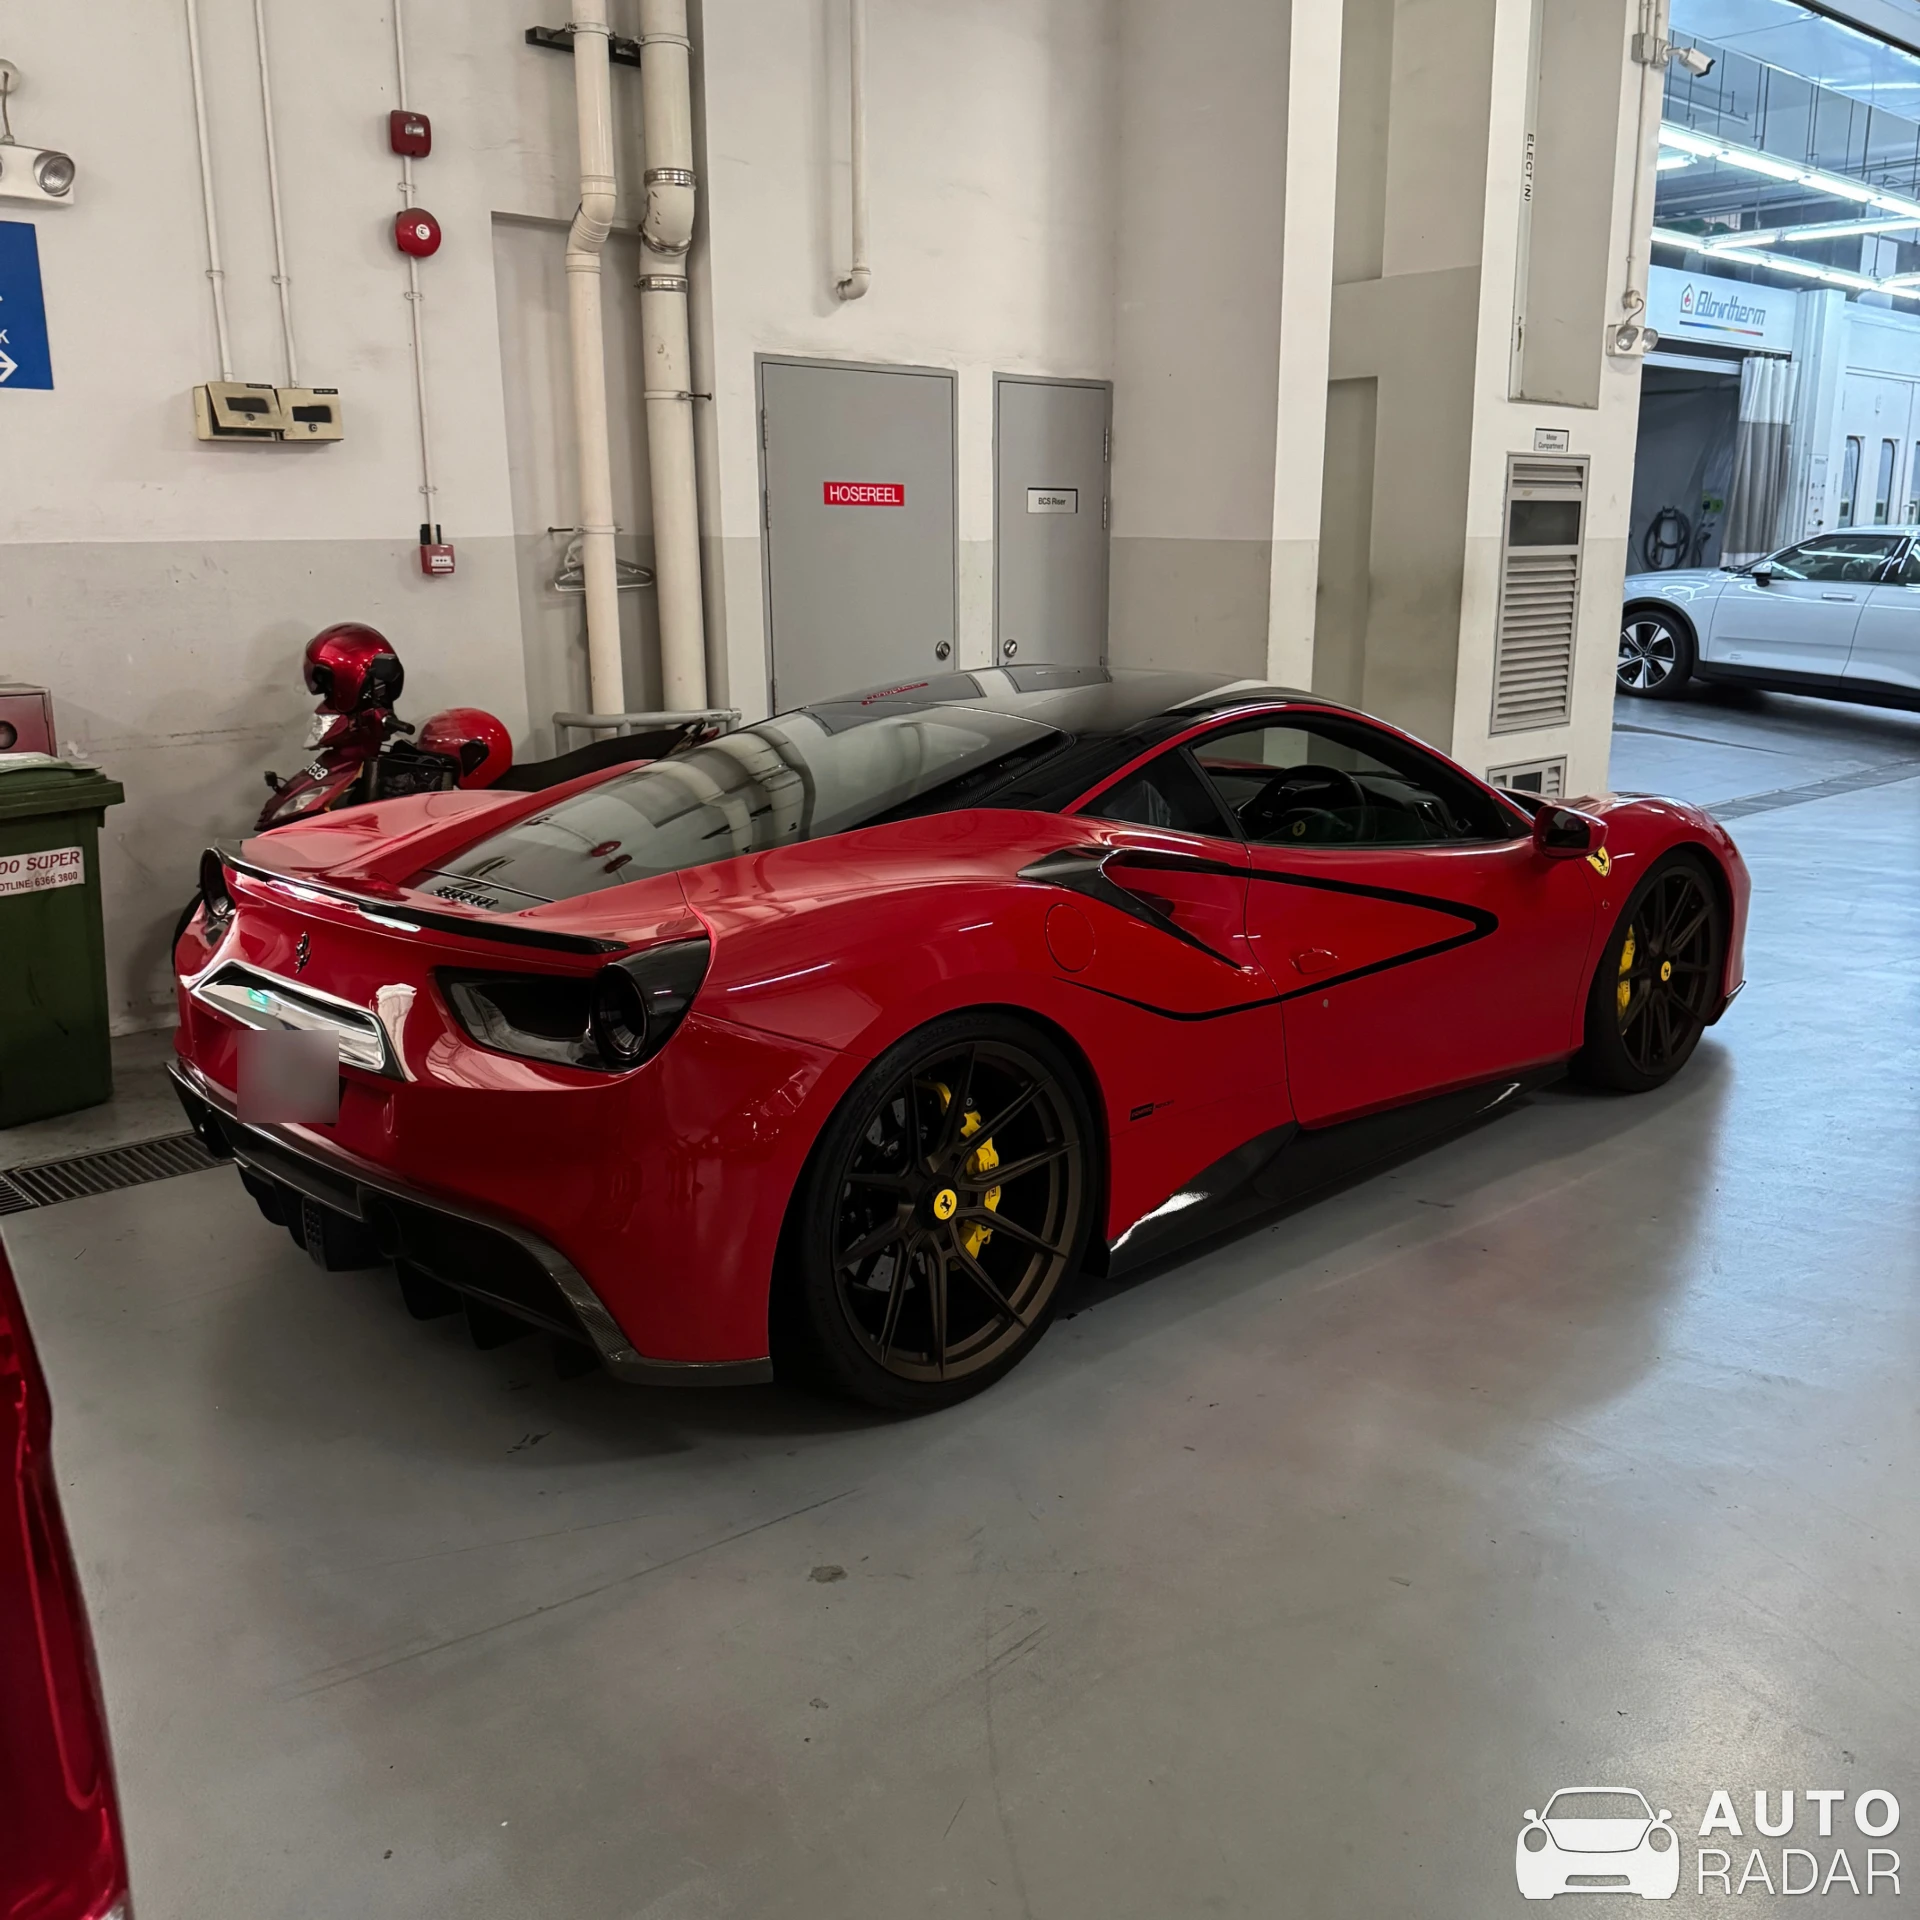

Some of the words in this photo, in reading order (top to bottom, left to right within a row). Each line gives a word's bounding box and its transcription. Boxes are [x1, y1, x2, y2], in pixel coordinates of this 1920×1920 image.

[1525, 133, 1535, 180] ELECT
[1523, 183, 1532, 202] (N)
[1695, 290, 1766, 326] Blowtherm
[829, 485, 900, 503] HOSEREEL
[1038, 497, 1051, 505] BCS
[26, 851, 80, 871] SUPER
[35, 875, 56, 887] 6366
[58, 871, 78, 883] 3800
